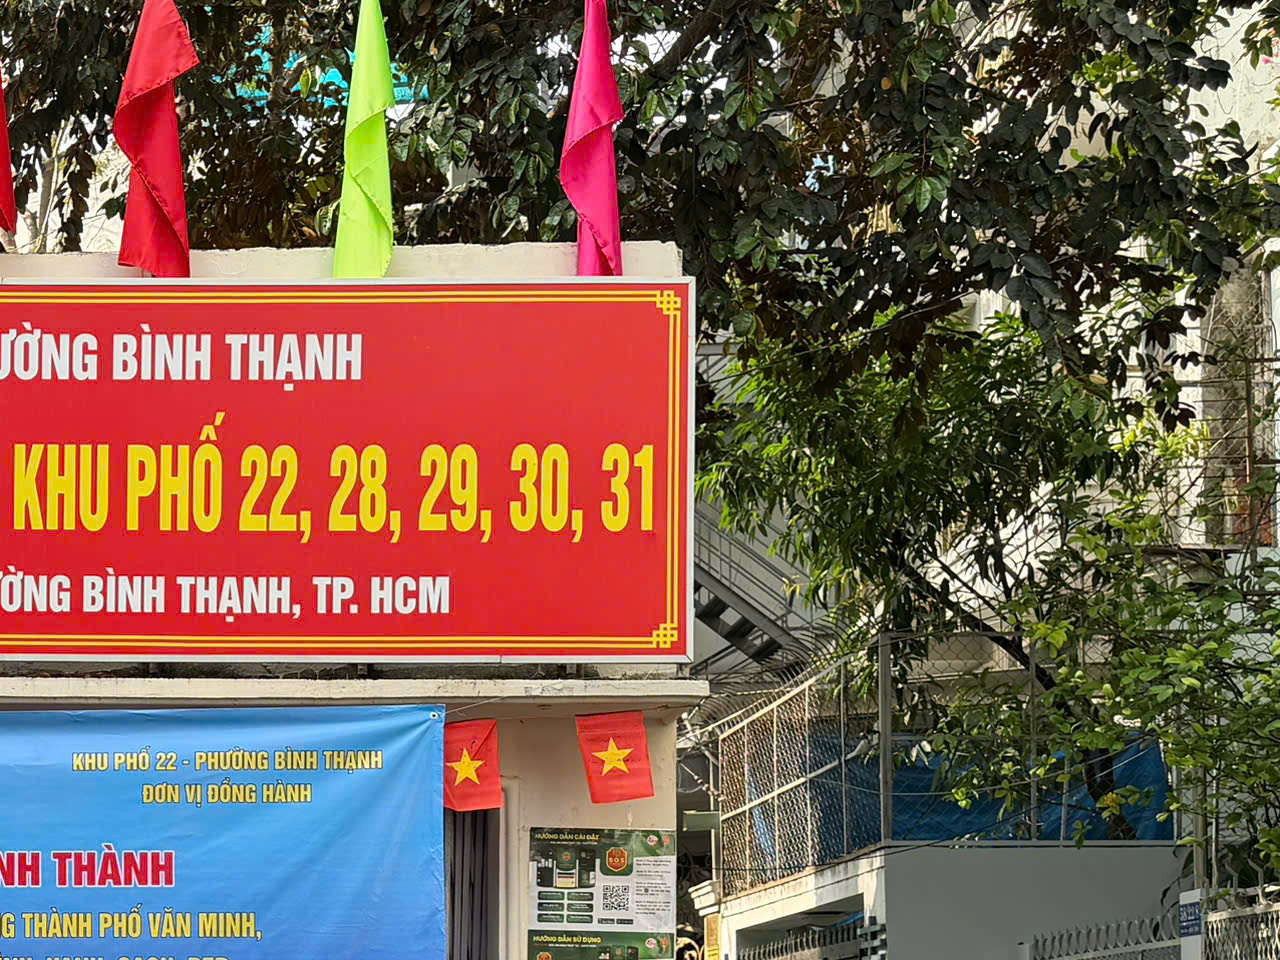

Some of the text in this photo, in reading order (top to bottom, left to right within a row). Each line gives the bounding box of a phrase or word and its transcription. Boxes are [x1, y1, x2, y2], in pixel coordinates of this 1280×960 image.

[113, 324, 211, 380] BÌNH
[225, 334, 362, 391] THẠNH
[14, 444, 109, 531] KHU
[127, 412, 225, 532] PHỐ
[239, 445, 311, 543] 22,
[329, 445, 400, 543] 28,
[419, 444, 491, 542] 29,
[510, 444, 583, 542] 30,
[601, 444, 653, 531] 31
[83, 568, 165, 612] BÌNH
[177, 577, 300, 622] THẠNH,
[313, 577, 358, 613] TP.
[371, 576, 449, 614] HCM
[73, 753, 109, 771] KHU
[114, 745, 150, 771] PHỐ
[156, 752, 177, 771] 22
[195, 749, 269, 770] PHƯỜNG
[274, 751, 318, 770] BÌNH
[323, 751, 383, 773] THẠNH
[143, 780, 312, 807] ĐƠN VỊ ĐỒNG HÀNH
[51, 842, 175, 888] THÀNH
[22, 907, 92, 938] THÀNH
[99, 902, 141, 938] PHỐ
[148, 909, 191, 938] VĂN
[199, 913, 262, 938] MINH,
